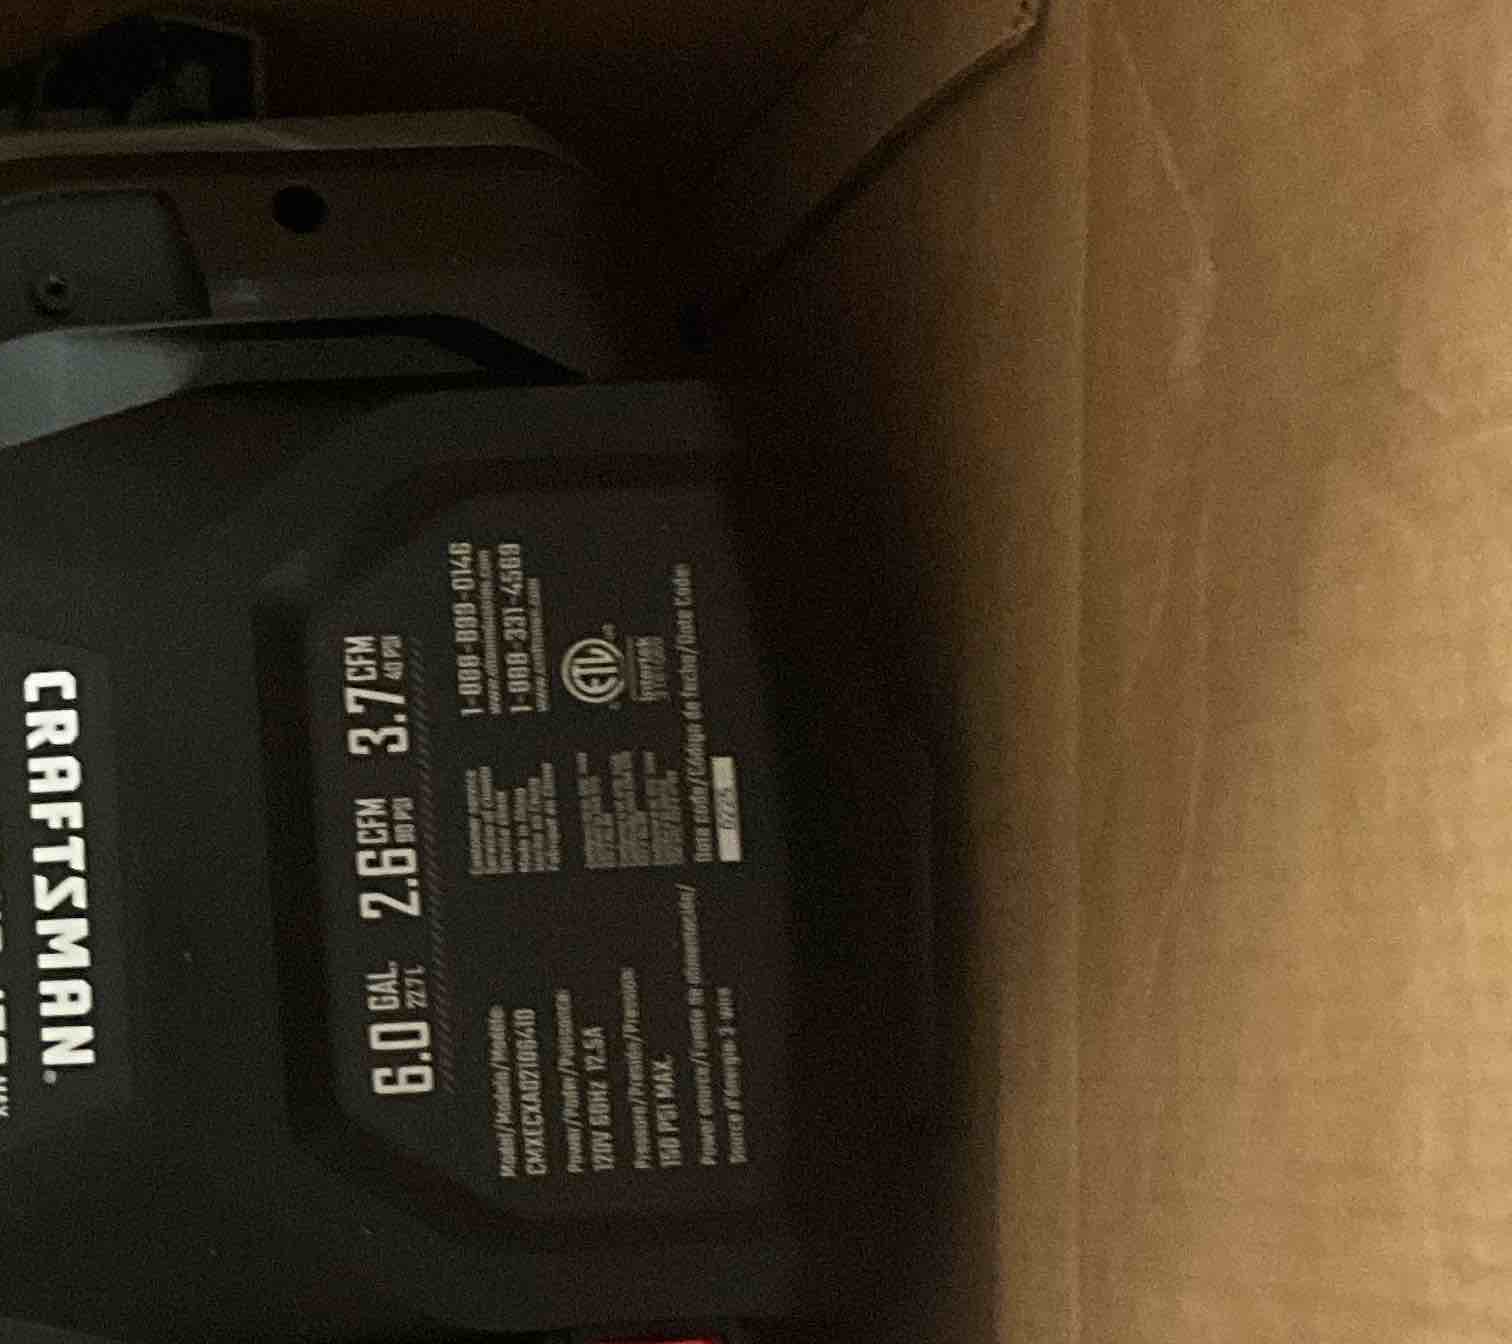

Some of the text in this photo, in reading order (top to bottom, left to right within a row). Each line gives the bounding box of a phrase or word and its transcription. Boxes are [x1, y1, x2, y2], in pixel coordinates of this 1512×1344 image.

[343, 635, 409, 755] 3.7 CFM
[23, 671, 95, 1066] CRAFTSMAN
[353, 798, 421, 919] 2.6 CFM
[365, 960, 434, 1095] 6.0 GAL.
